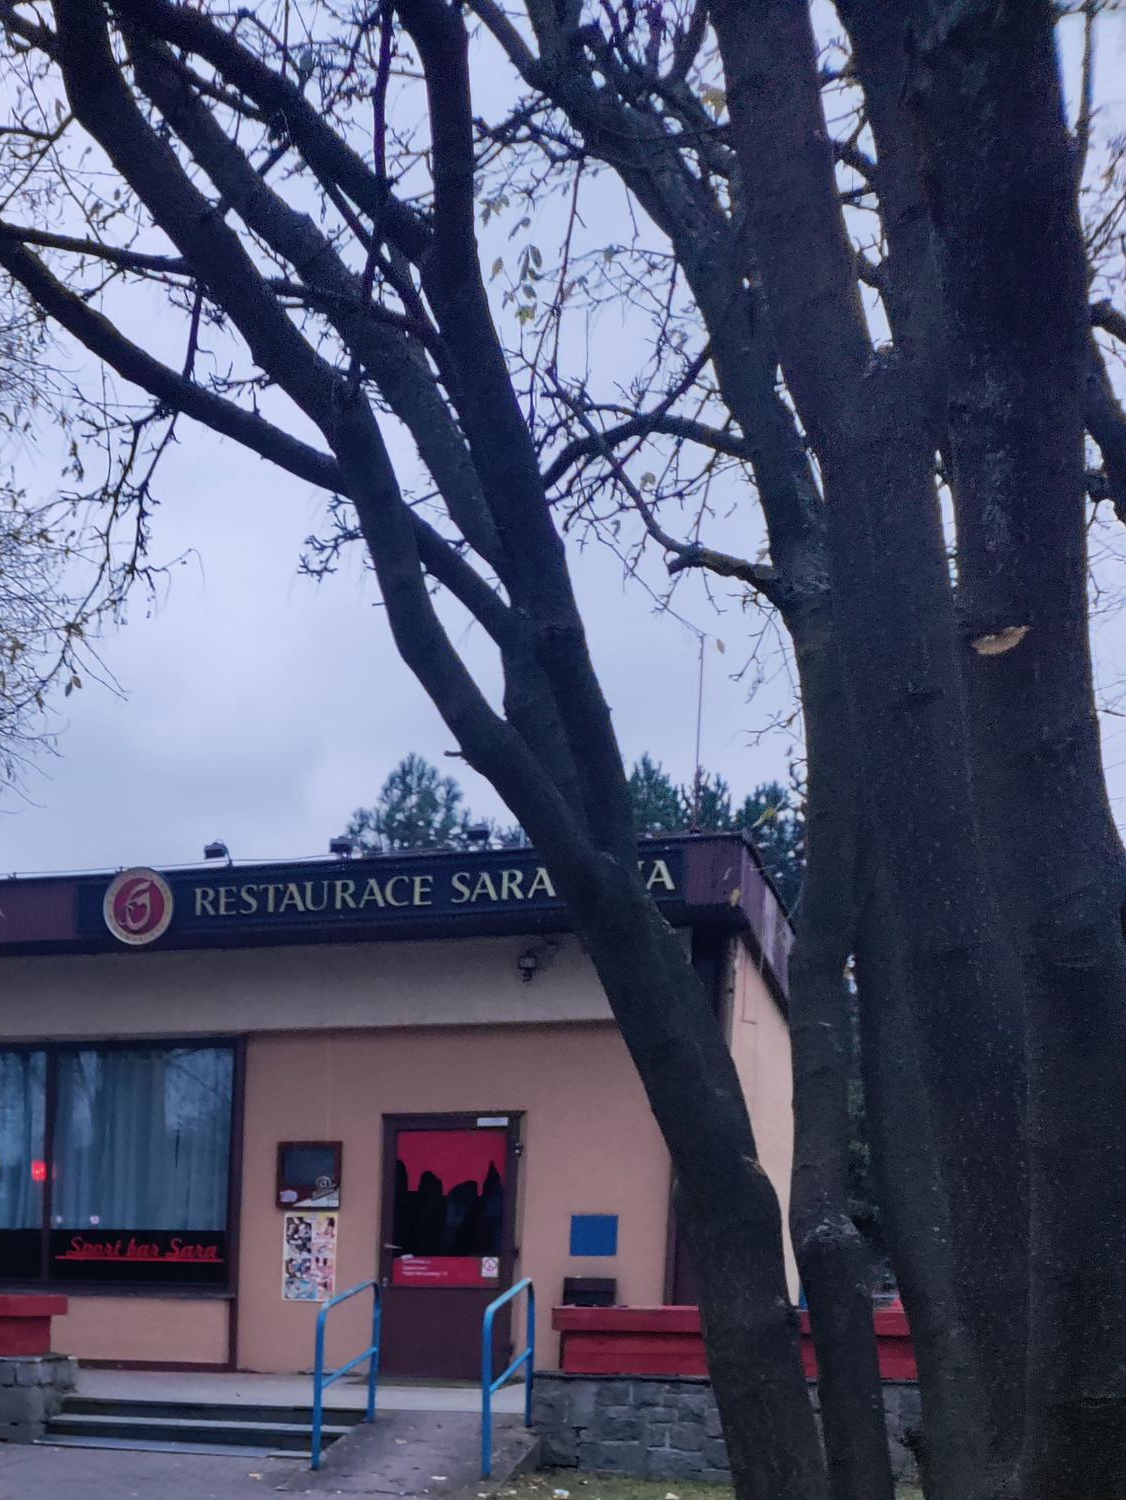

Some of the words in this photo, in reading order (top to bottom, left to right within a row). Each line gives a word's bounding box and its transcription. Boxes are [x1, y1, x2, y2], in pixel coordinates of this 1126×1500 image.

[194, 875, 434, 916] RESTAURACE
[66, 1236, 122, 1259] Sport
[127, 1237, 159, 1258] bar
[165, 1238, 218, 1260] Sara
